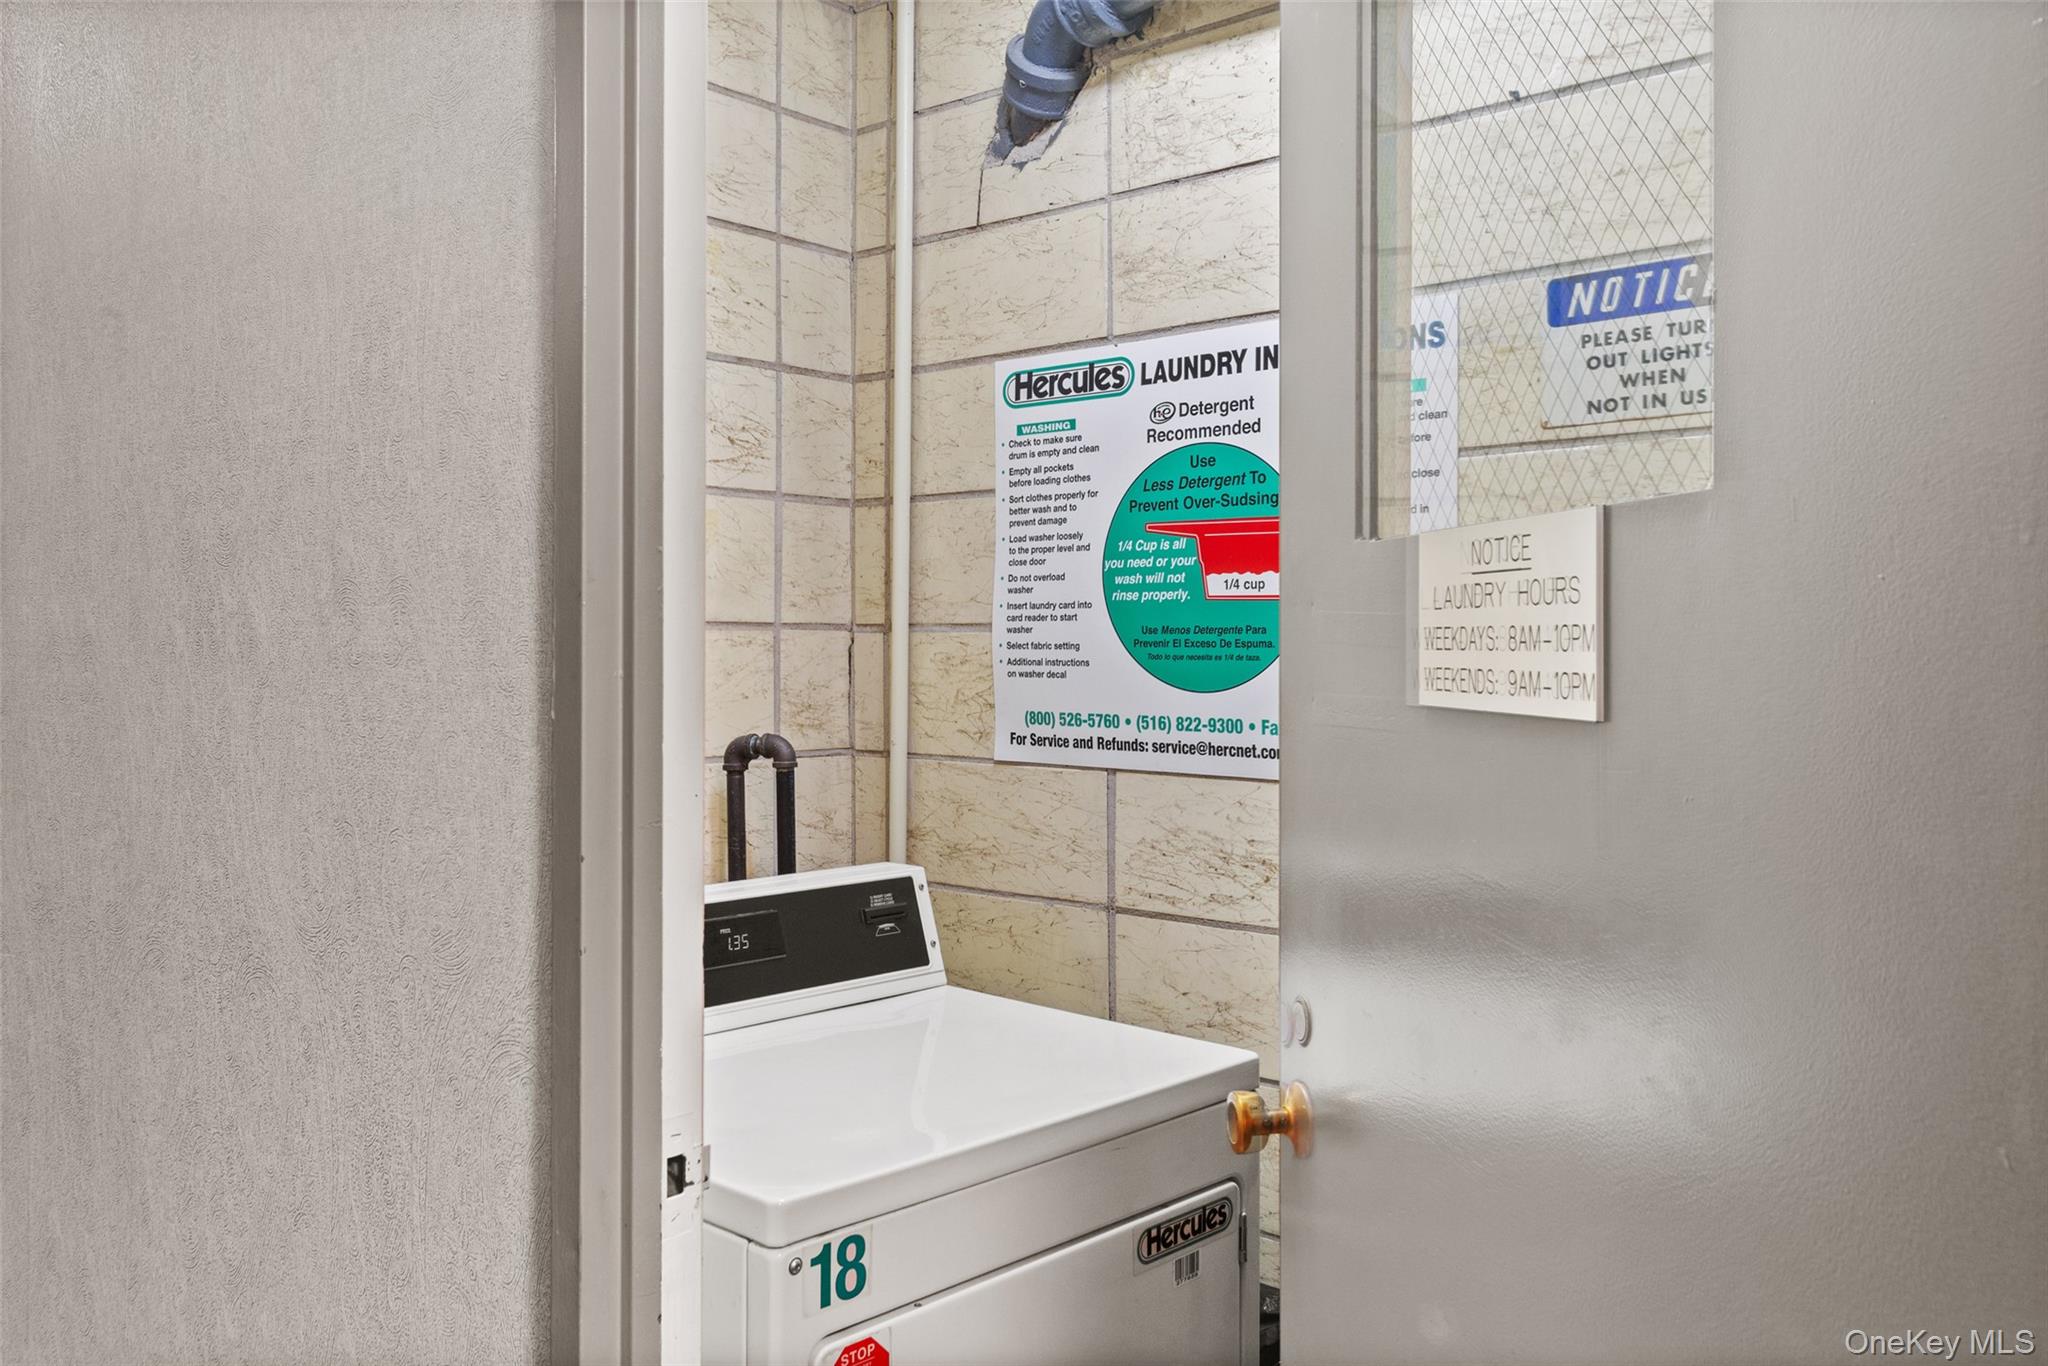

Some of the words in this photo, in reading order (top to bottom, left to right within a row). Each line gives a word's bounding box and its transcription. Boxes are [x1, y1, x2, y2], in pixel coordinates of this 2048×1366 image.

[1581, 326, 1653, 349] PLEASE
[1666, 319, 1712, 338] TUR
[1586, 351, 1628, 370] OUT
[1014, 363, 1125, 401] Hercules
[1140, 348, 1248, 386] LAUNDRY
[1619, 367, 1686, 389] WHEN
[1179, 395, 1255, 417] Detergent
[1587, 396, 1630, 415] NOT
[1642, 392, 1667, 410] IN
[1418, 410, 1448, 421] clean
[1021, 421, 1071, 434] WASHING
[1146, 417, 1262, 444] Recommended
[1008, 439, 1032, 449] Check
[1033, 438, 1041, 446] to
[1042, 436, 1064, 445] make
[1065, 434, 1083, 443] sure
[1008, 451, 1028, 460] drum
[1029, 450, 1036, 458] is
[1037, 448, 1061, 458] empty
[1062, 446, 1077, 455] and
[1078, 444, 1100, 454] clean
[1190, 454, 1216, 468] Use
[1009, 467, 1032, 477] Empty
[1033, 465, 1042, 474] all
[1043, 463, 1074, 474] pockets
[1411, 468, 1440, 478] close
[1009, 478, 1032, 488] before
[1033, 476, 1061, 486] loading
[1062, 473, 1091, 484] clothes
[1143, 478, 1174, 492] Less
[1178, 471, 1247, 490] Detergent
[1250, 470, 1267, 485] To
[1009, 495, 1024, 504] Sort
[1025, 493, 1053, 502] clothes
[1054, 491, 1086, 502] properly
[1087, 489, 1099, 498] for
[1129, 498, 1179, 512] Prevent
[1183, 491, 1279, 510] Over-Sudsing
[1009, 507, 1031, 516] better
[1031, 505, 1052, 514] wash
[1053, 503, 1068, 513] and
[1069, 503, 1077, 512] to
[1009, 518, 1036, 529] prevent
[1037, 516, 1068, 527] damage
[1009, 534, 1027, 543] Load
[1028, 533, 1055, 542] washer
[1056, 531, 1083, 541] loosely
[1009, 547, 1016, 555] to
[1018, 546, 1029, 554] the
[1030, 546, 1055, 555] proper
[1056, 543, 1074, 552] level
[1075, 543, 1091, 552] and
[1117, 540, 1133, 552] 1/4
[1135, 539, 1158, 553] Cup
[1160, 538, 1170, 550] is
[1172, 537, 1187, 549] all
[1471, 533, 1532, 566] NOTICE
[1008, 558, 1027, 566] close
[1028, 557, 1047, 566] door
[1104, 558, 1124, 571] you
[1126, 556, 1154, 568] need
[1156, 557, 1168, 567] or
[1170, 556, 1197, 569] your
[1007, 574, 1018, 582] Do
[1019, 574, 1032, 582] not
[1032, 572, 1066, 582] overload
[1114, 573, 1143, 585] wash
[1145, 572, 1164, 584] will
[1166, 572, 1186, 583] not
[1007, 586, 1034, 594] washer
[1223, 578, 1240, 590] 1/4
[1243, 580, 1266, 592] cup
[1433, 581, 1507, 610] LAUNDRY
[1517, 575, 1581, 607] HOURS
[1111, 590, 1139, 601] rinse
[1141, 588, 1191, 603] properly.
[1006, 601, 1028, 610] Insert
[1029, 601, 1057, 611] laundry
[1058, 600, 1076, 609] card
[1077, 600, 1093, 609] into
[1006, 614, 1023, 622] card
[1024, 613, 1049, 622] reader
[1050, 613, 1058, 621] to
[1060, 613, 1078, 621] start
[1006, 625, 1033, 634] washer
[1141, 625, 1158, 635] Use
[1161, 625, 1191, 635] Menos
[1193, 625, 1243, 636] Detergente
[1245, 625, 1267, 635] Para
[1133, 639, 1170, 648] Prevenir
[1172, 639, 1182, 648] El
[1184, 639, 1217, 648] Exceso
[1219, 639, 1232, 648] De
[1234, 639, 1276, 650] Espuma.
[1424, 625, 1499, 652] WEEKDAYS:
[1006, 641, 1029, 650] Select
[1030, 641, 1052, 650] fabric
[1053, 641, 1081, 652] setting
[1006, 658, 1043, 666] Additional
[1045, 658, 1090, 667] instructions
[1007, 670, 1017, 678] on
[1018, 670, 1045, 678] washer
[1046, 670, 1067, 679] decal
[1424, 667, 1499, 695] WEEKENDS:
[1024, 710, 1056, 729] (800)
[1058, 711, 1121, 729] 526-5760
[1136, 714, 1172, 734] (516)
[1175, 716, 1244, 734] 822-9300
[1010, 732, 1028, 746] For
[1029, 732, 1070, 749] Service
[1072, 735, 1094, 749] and
[1097, 737, 1149, 753] Refunds:
[1147, 1204, 1227, 1257] Hercules
[810, 1233, 867, 1310] 18
[840, 1343, 876, 1366] STOP
